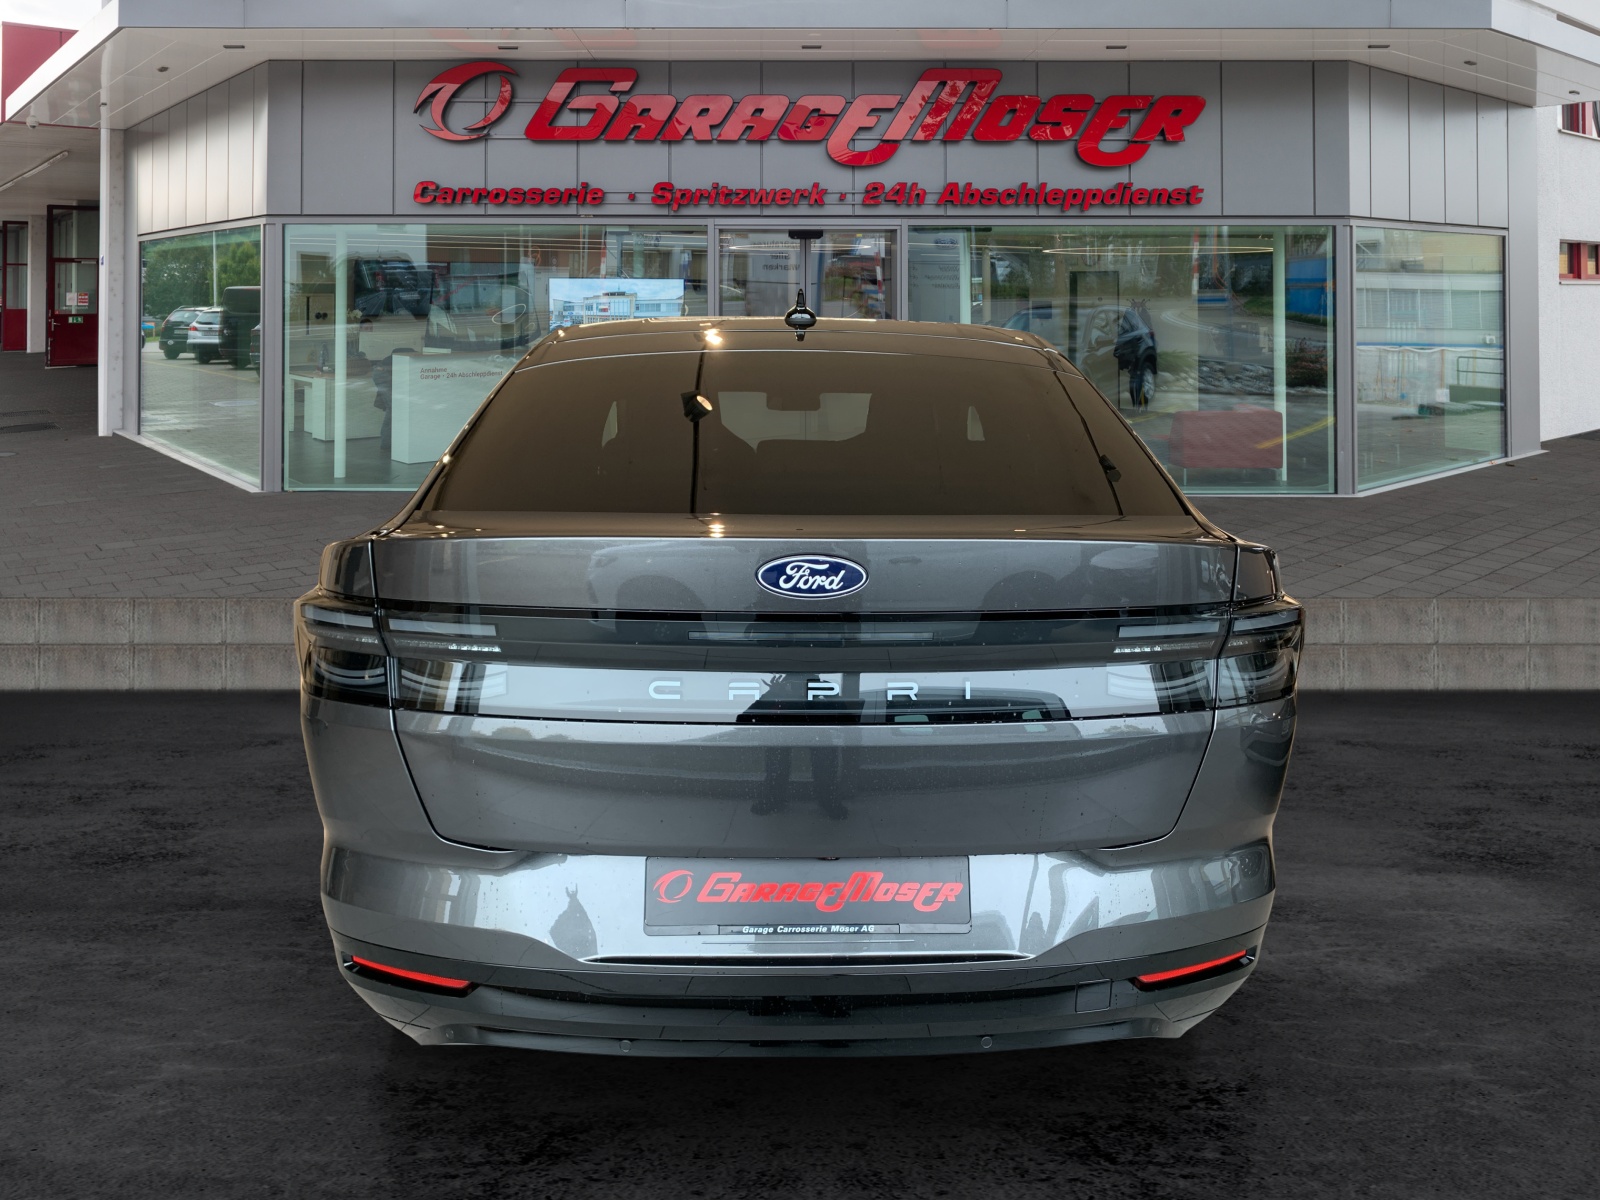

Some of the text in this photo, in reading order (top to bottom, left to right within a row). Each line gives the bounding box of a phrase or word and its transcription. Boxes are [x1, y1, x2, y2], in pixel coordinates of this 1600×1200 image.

[413, 181, 1204, 212] Carrosserie Spritzwerk 24h Abschleppdienst
[778, 561, 845, 591] Ford
[648, 681, 970, 700] CAPRI
[742, 925, 875, 935] Garage Carrosserie Moser AG
